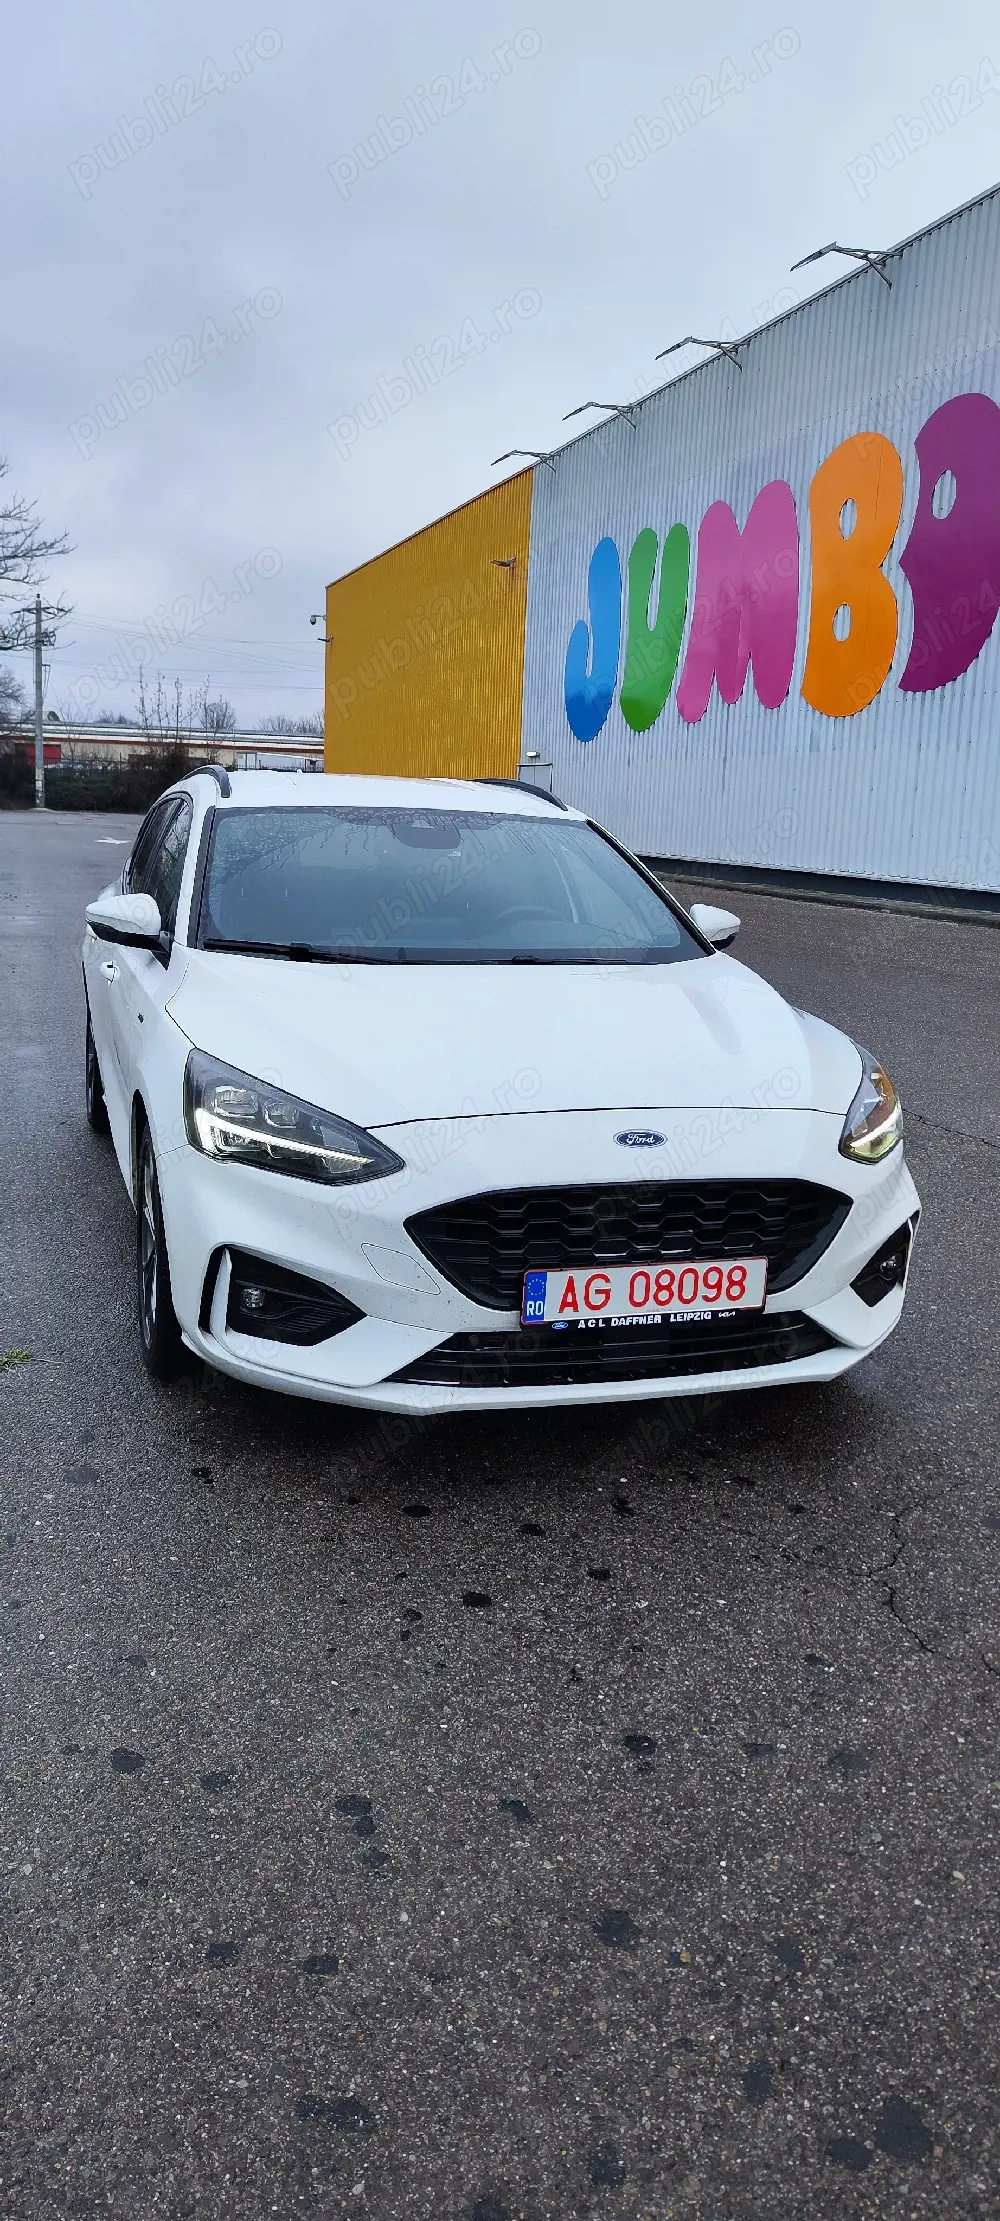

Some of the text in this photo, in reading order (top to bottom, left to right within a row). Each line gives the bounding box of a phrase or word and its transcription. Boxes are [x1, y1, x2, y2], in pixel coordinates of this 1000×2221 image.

[558, 1264, 748, 1314] AG 08098
[526, 1301, 543, 1316] RO
[611, 1314, 661, 1326] DAFFNER
[670, 1311, 711, 1322] LEIPZIG
